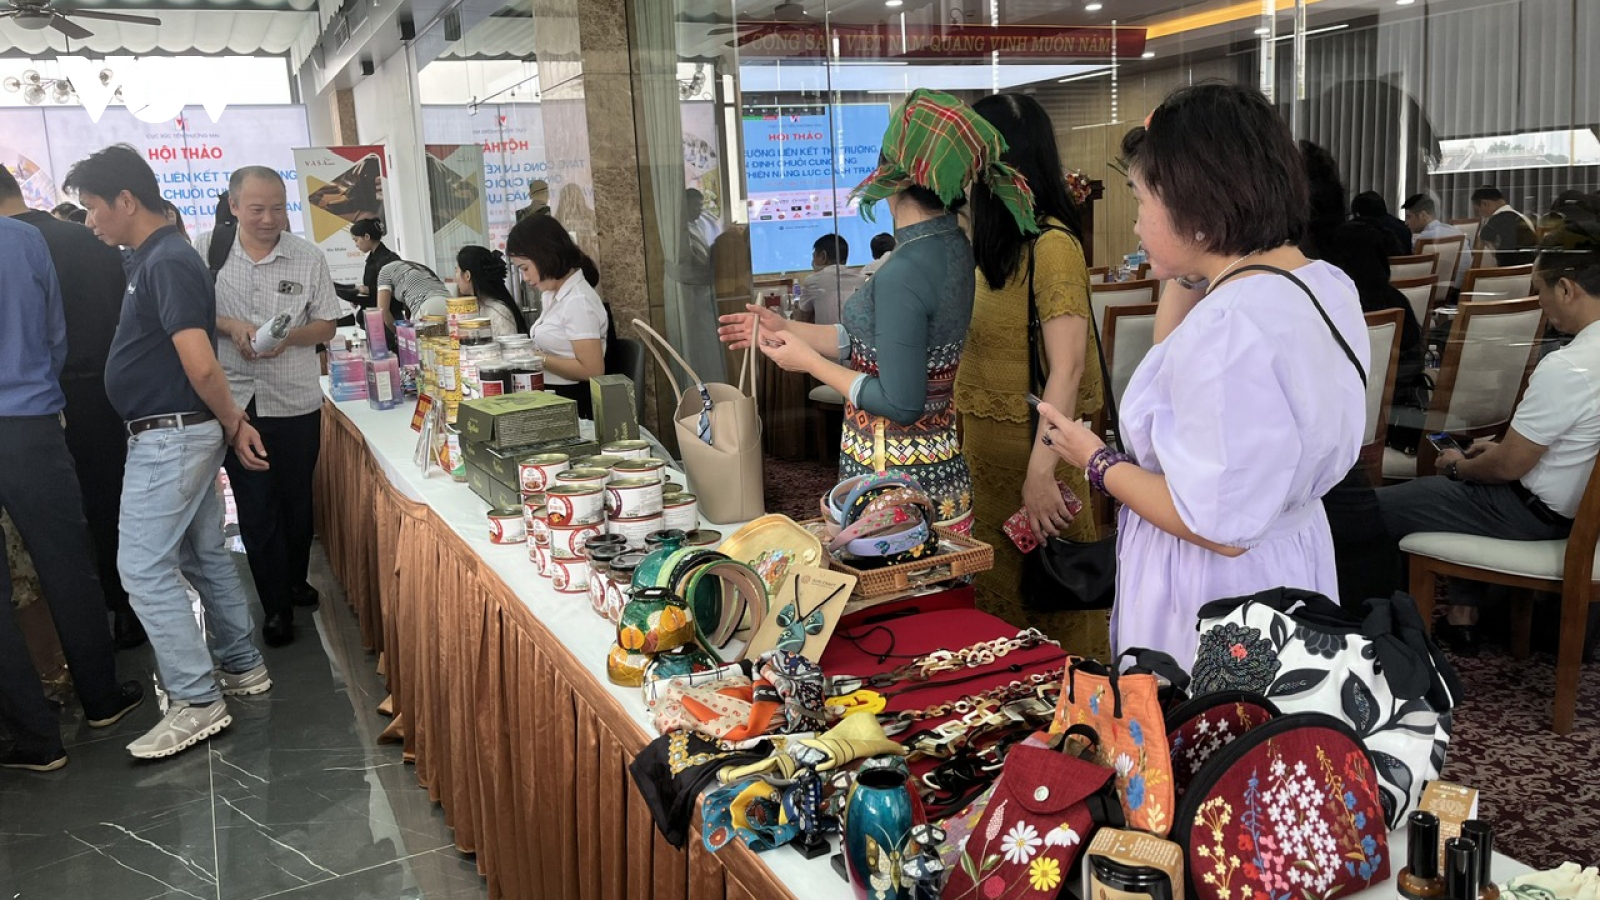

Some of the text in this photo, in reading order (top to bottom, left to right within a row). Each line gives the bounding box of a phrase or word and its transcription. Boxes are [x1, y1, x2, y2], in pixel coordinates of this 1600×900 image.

[930, 33, 985, 52] QUANG
[990, 35, 1028, 52] VINH
[148, 143, 223, 163] HỘI THẢO
[194, 168, 220, 182] KẾT
